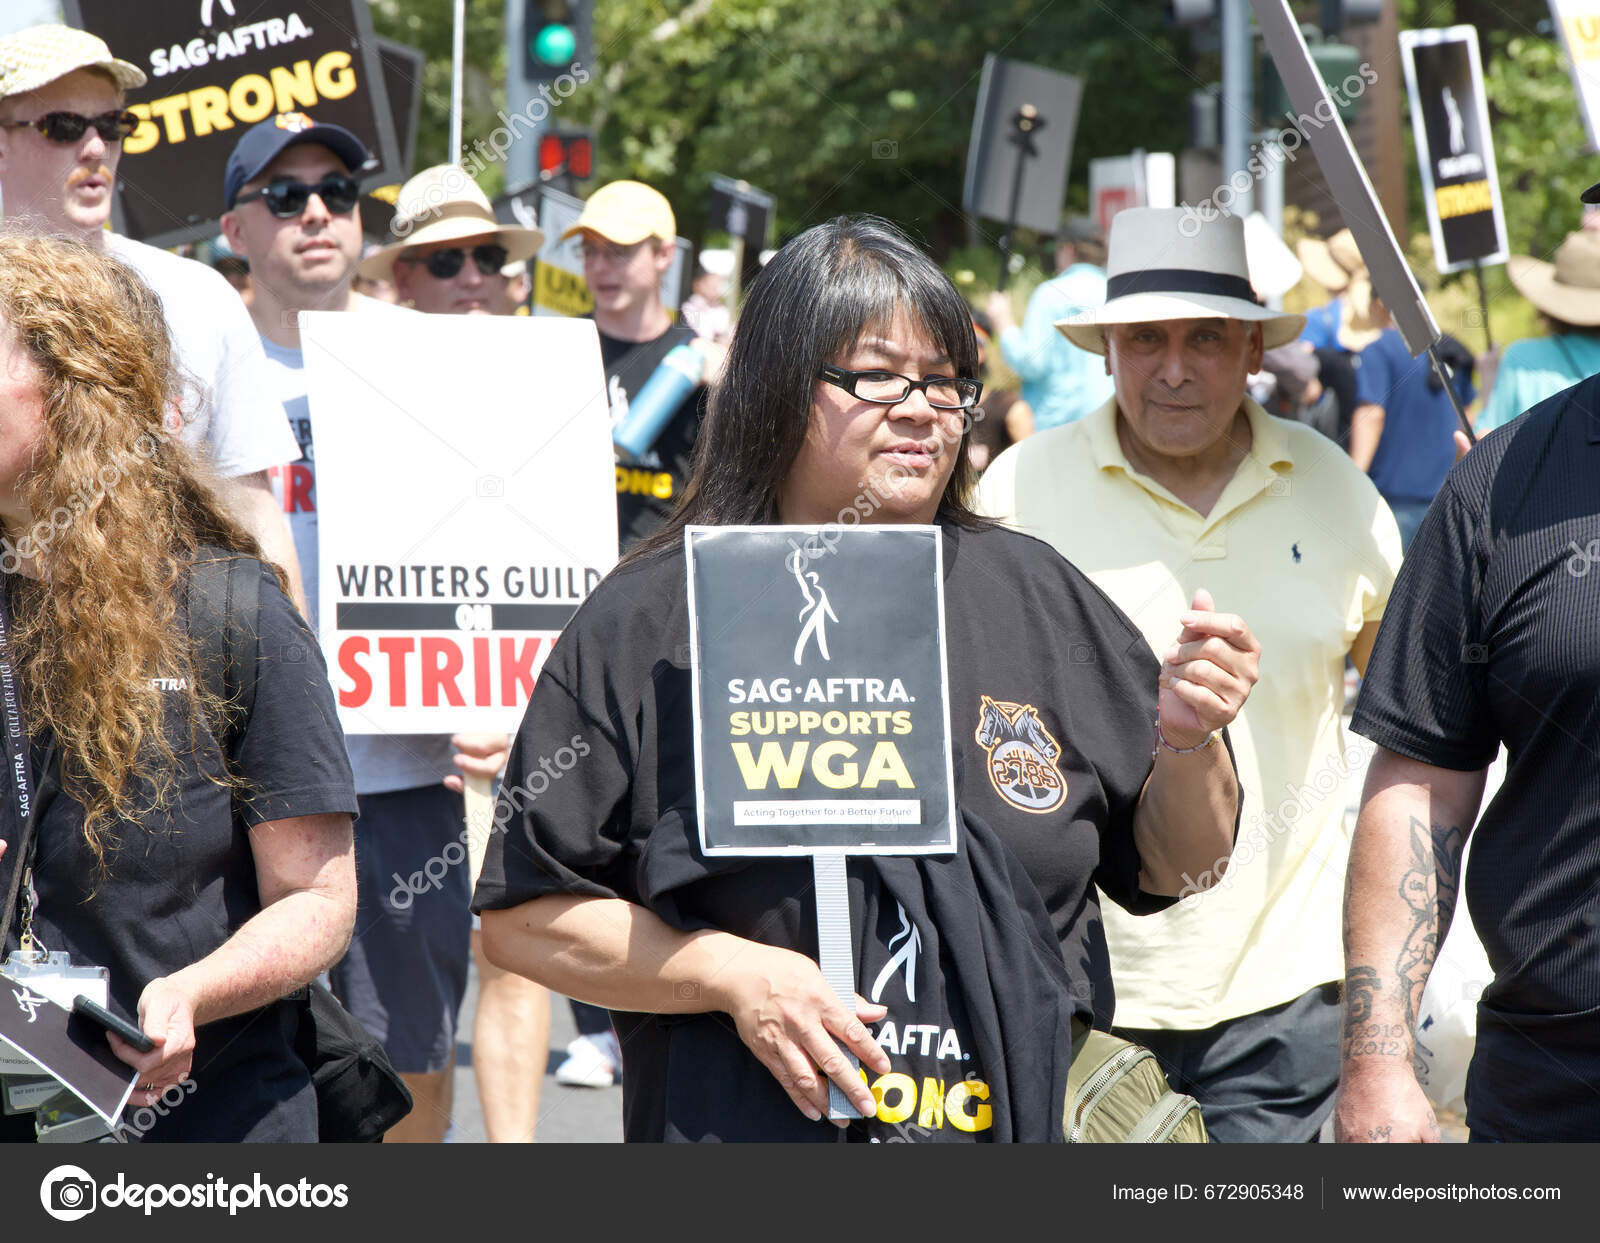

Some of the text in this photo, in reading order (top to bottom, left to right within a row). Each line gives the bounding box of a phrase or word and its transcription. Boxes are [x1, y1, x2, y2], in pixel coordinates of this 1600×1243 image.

[123, 51, 357, 154] STRONG
[337, 565, 490, 598] WRITERS
[337, 636, 554, 708] STRIK
[729, 710, 913, 735] SUPPORTS
[730, 740, 916, 790] WGA
[991, 758, 1061, 789] 2785
[743, 807, 912, 819] Acting Together for a Better Future
[857, 1072, 993, 1132] ONG
